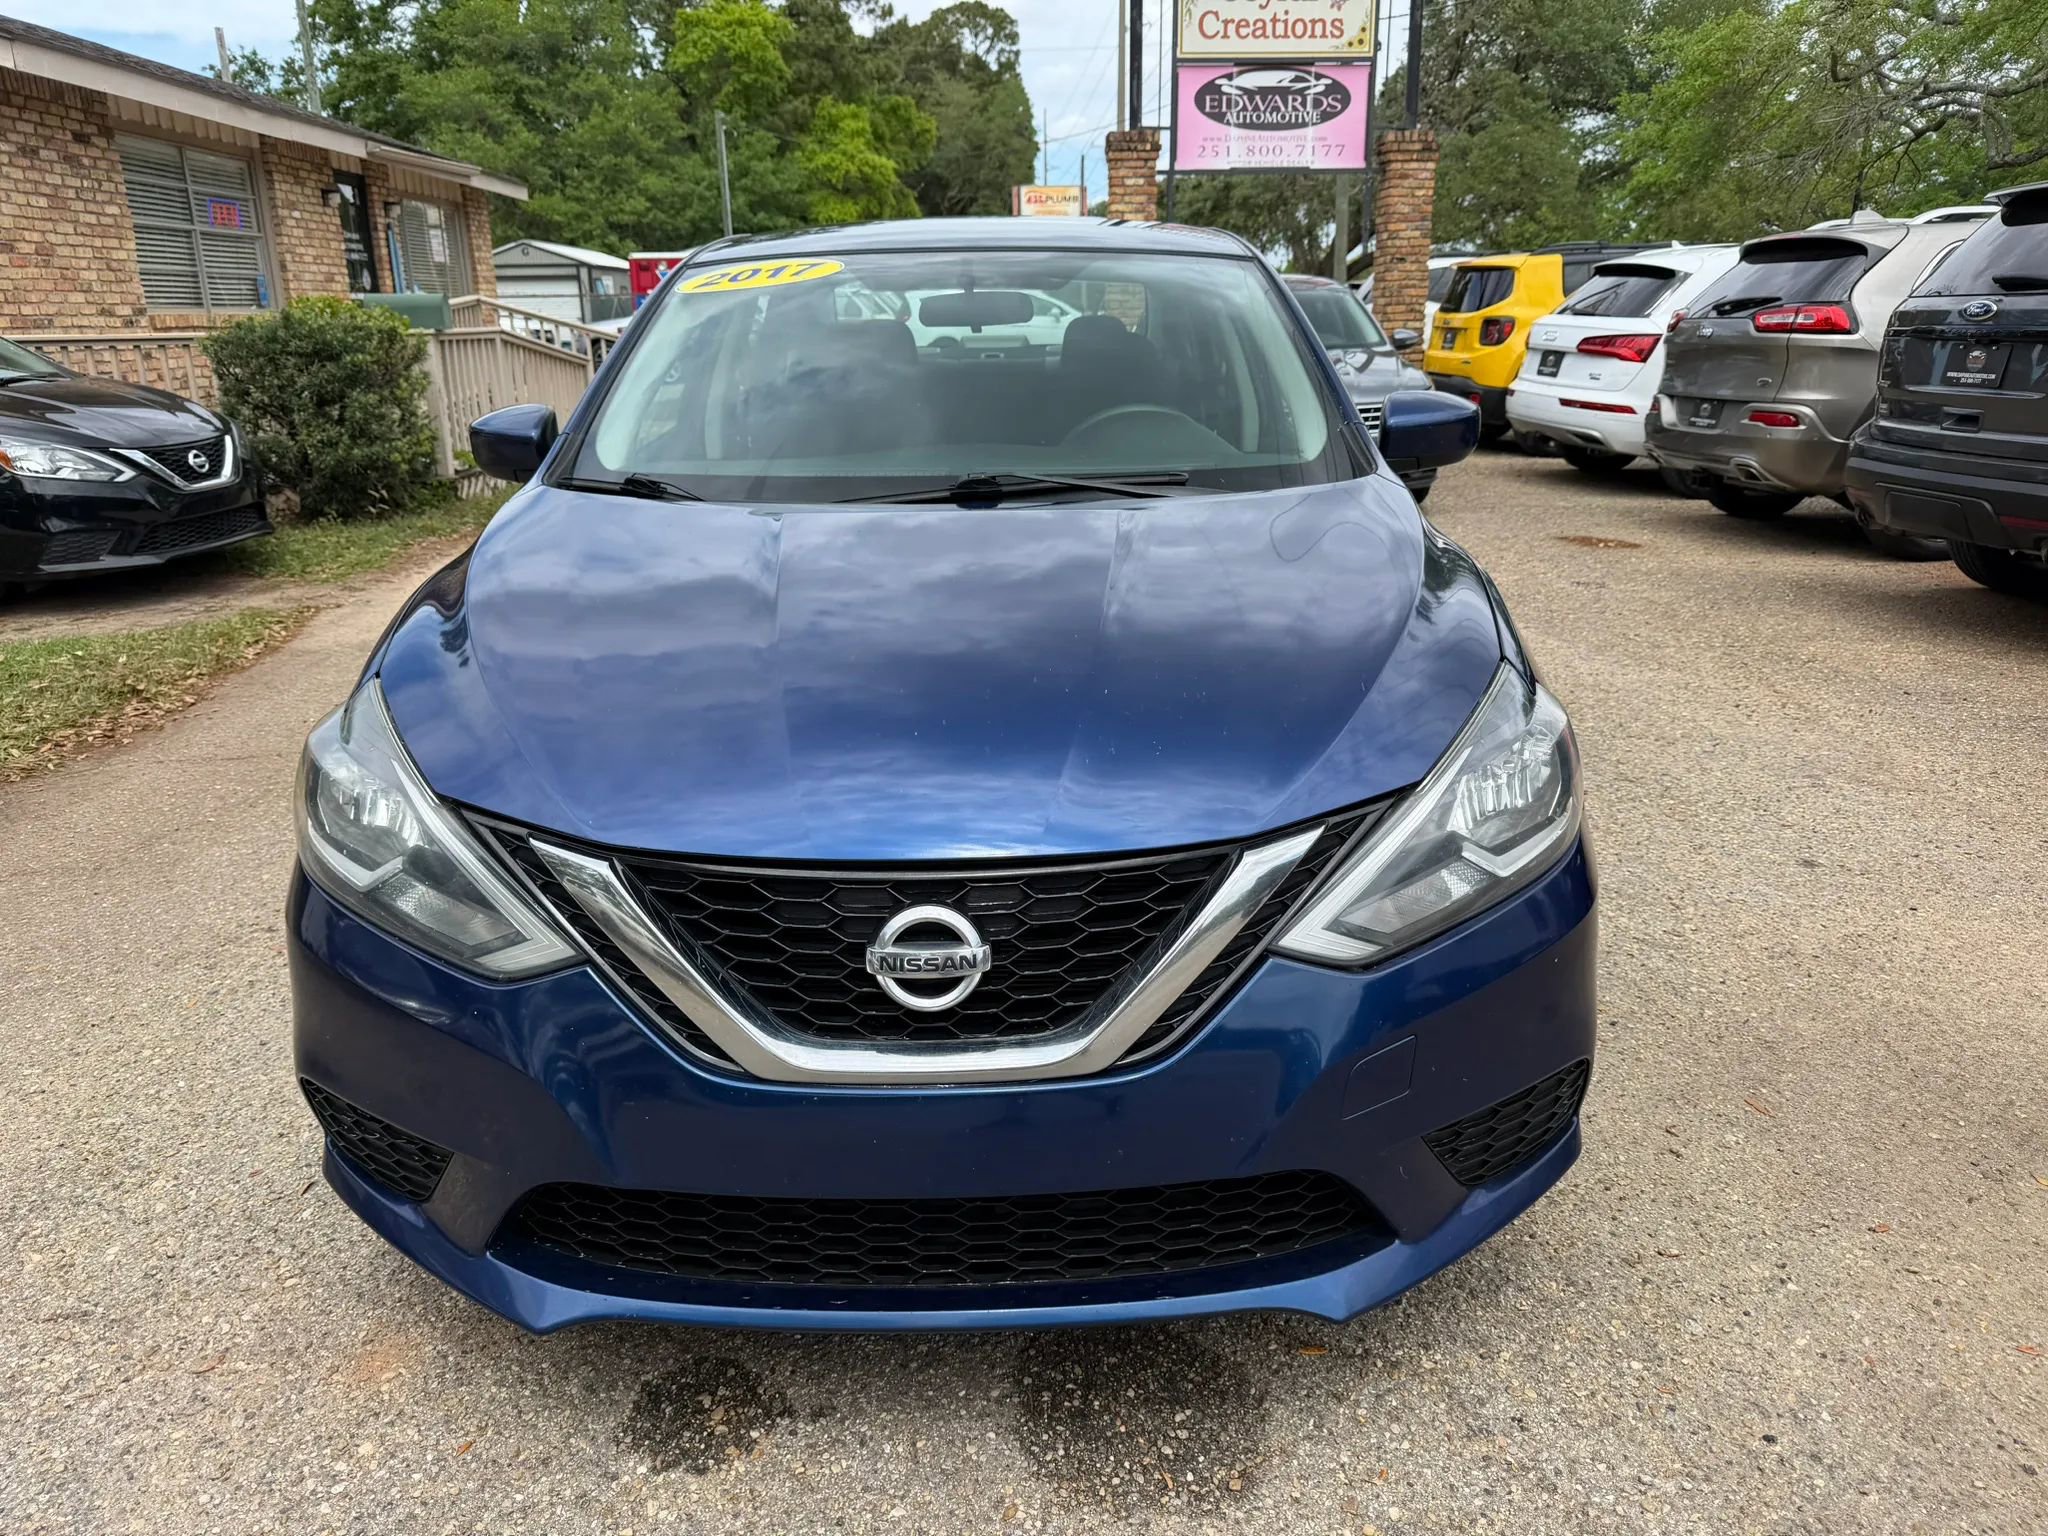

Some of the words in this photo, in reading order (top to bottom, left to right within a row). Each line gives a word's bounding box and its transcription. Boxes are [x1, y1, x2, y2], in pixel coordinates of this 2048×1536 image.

[1198, 10, 1344, 40] Creations
[1204, 94, 1342, 113] EDWARDS
[1223, 111, 1321, 123] AUTOMOTIVE
[1197, 144, 1346, 158] 251.800.7177
[692, 262, 826, 290] 2017
[879, 953, 977, 972] NISSAN
